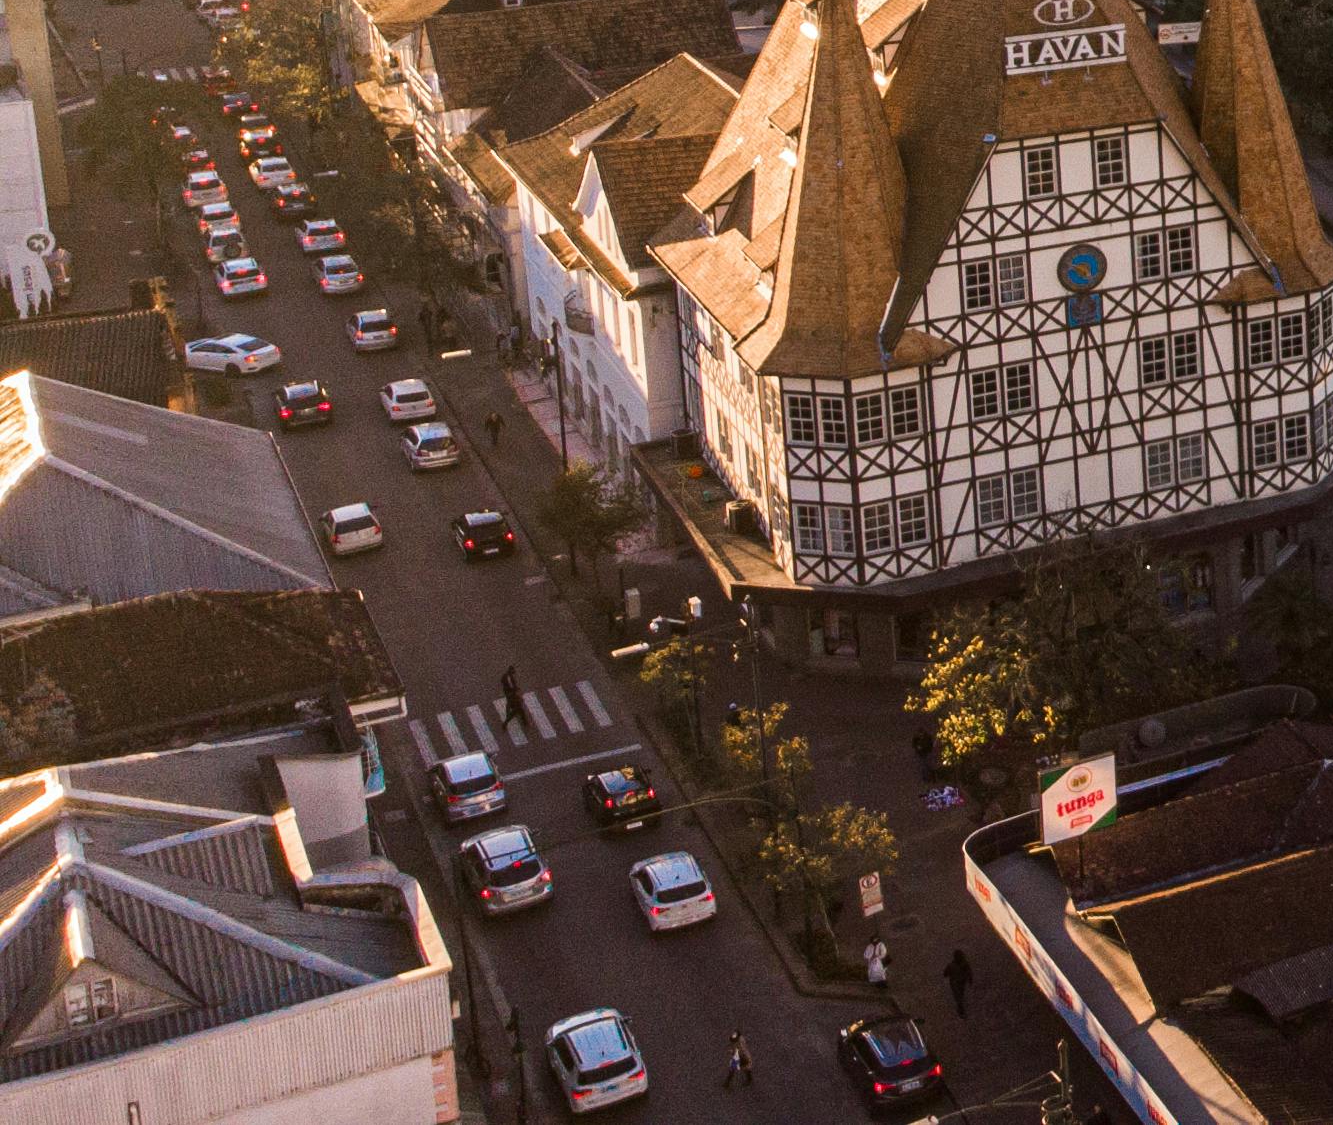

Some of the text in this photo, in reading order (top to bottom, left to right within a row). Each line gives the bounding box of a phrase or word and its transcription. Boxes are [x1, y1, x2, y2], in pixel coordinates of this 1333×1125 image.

[1052, 0, 1076, 21] H
[1005, 30, 1127, 69] HAVAN
[1056, 789, 1105, 818] tunga
